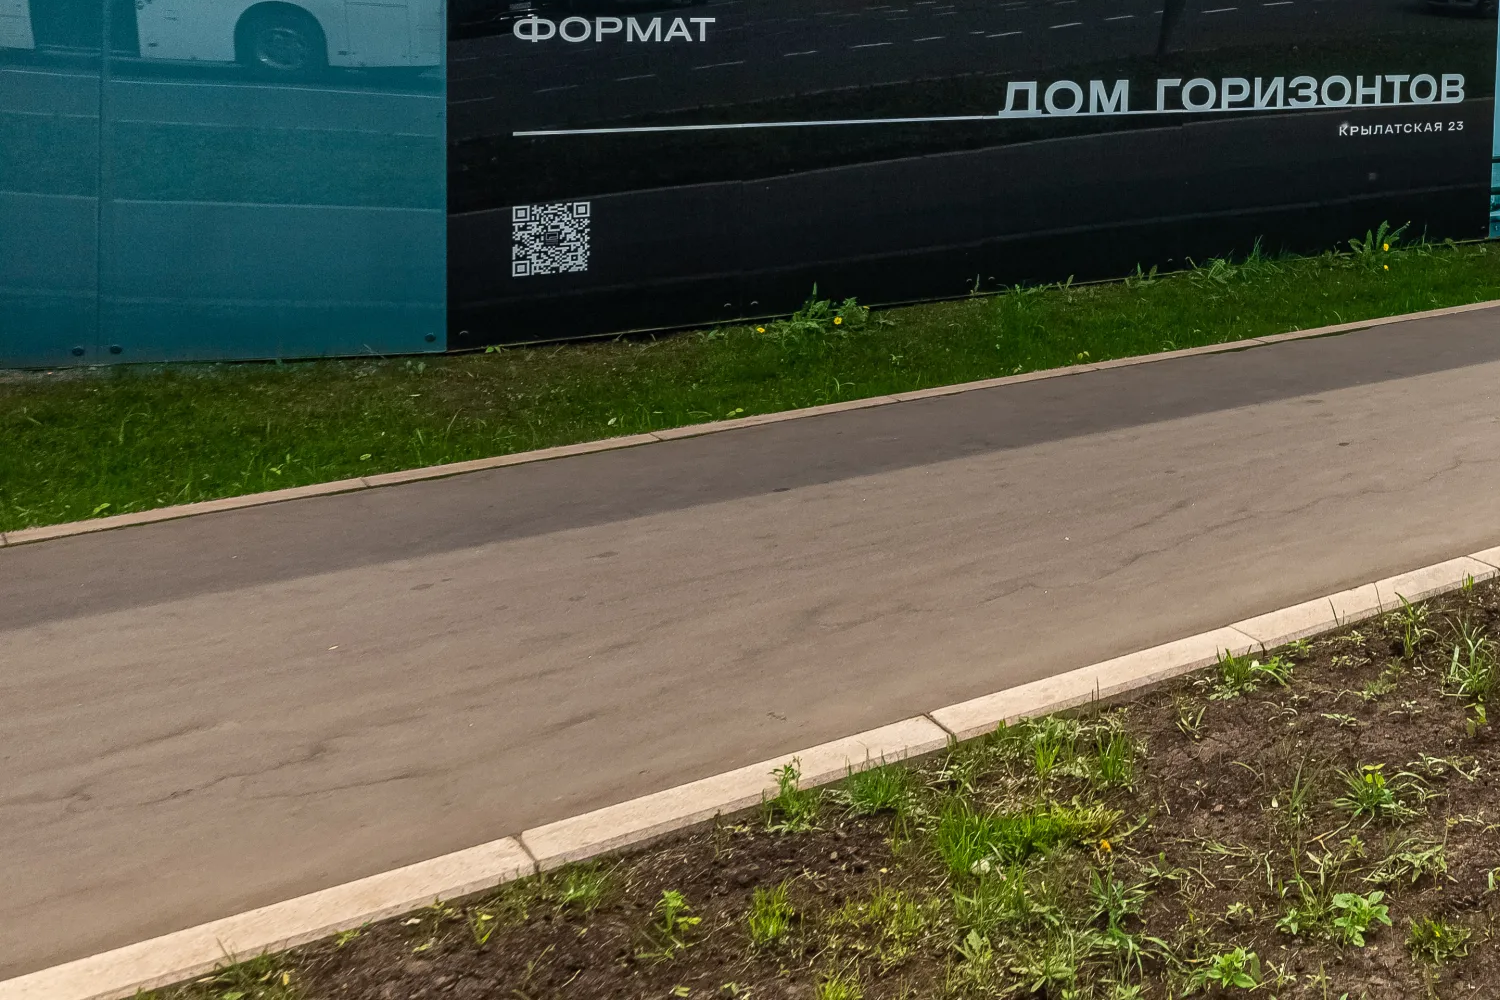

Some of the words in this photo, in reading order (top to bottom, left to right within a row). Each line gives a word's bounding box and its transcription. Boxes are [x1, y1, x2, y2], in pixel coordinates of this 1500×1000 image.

[513, 15, 716, 43] ФОРМАТ
[999, 79, 1130, 118] ДОМ
[1156, 73, 1465, 113] ГОРИЗОНТОВ
[1338, 121, 1443, 138] КРЫЛАТСКАЯ
[1447, 120, 1465, 132] 23
